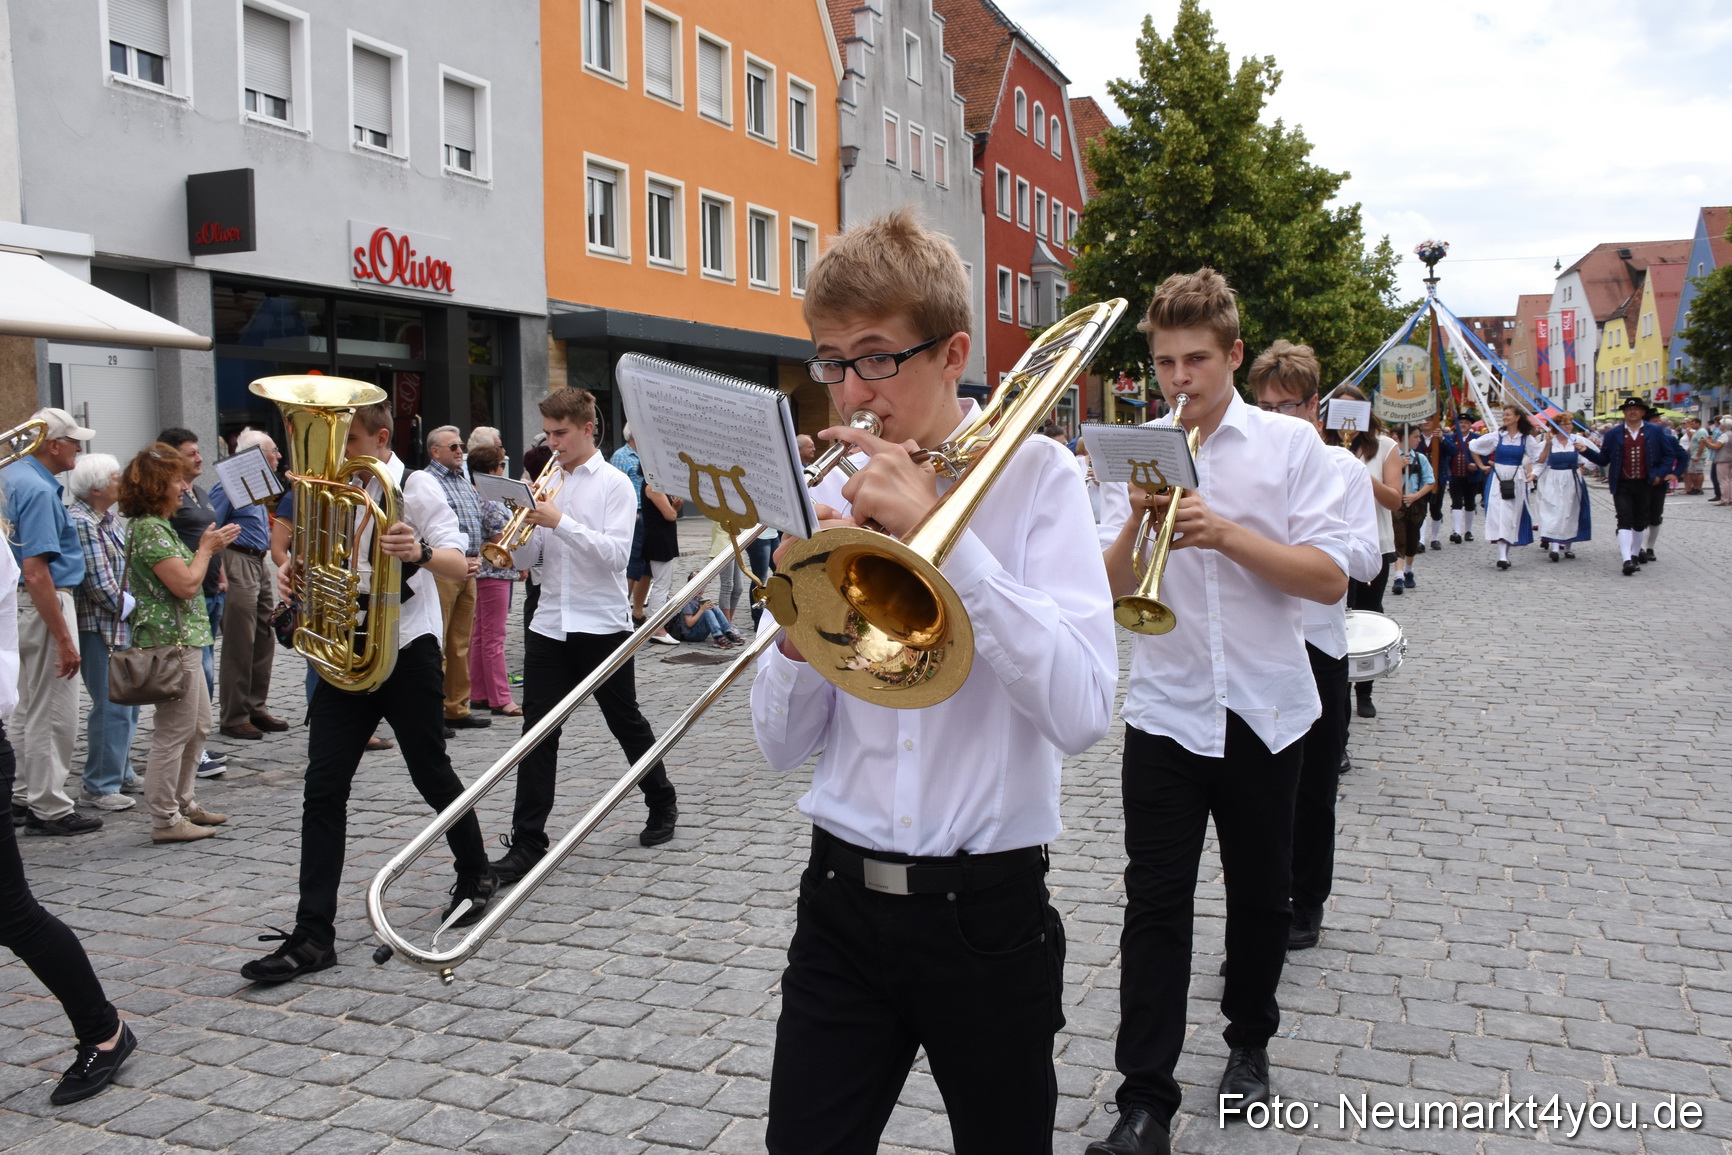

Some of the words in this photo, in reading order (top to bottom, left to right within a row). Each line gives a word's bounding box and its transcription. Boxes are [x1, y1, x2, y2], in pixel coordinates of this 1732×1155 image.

[195, 221, 242, 245] s.Oliver
[353, 226, 455, 293] s.Oliver
[108, 355, 118, 366] 29
